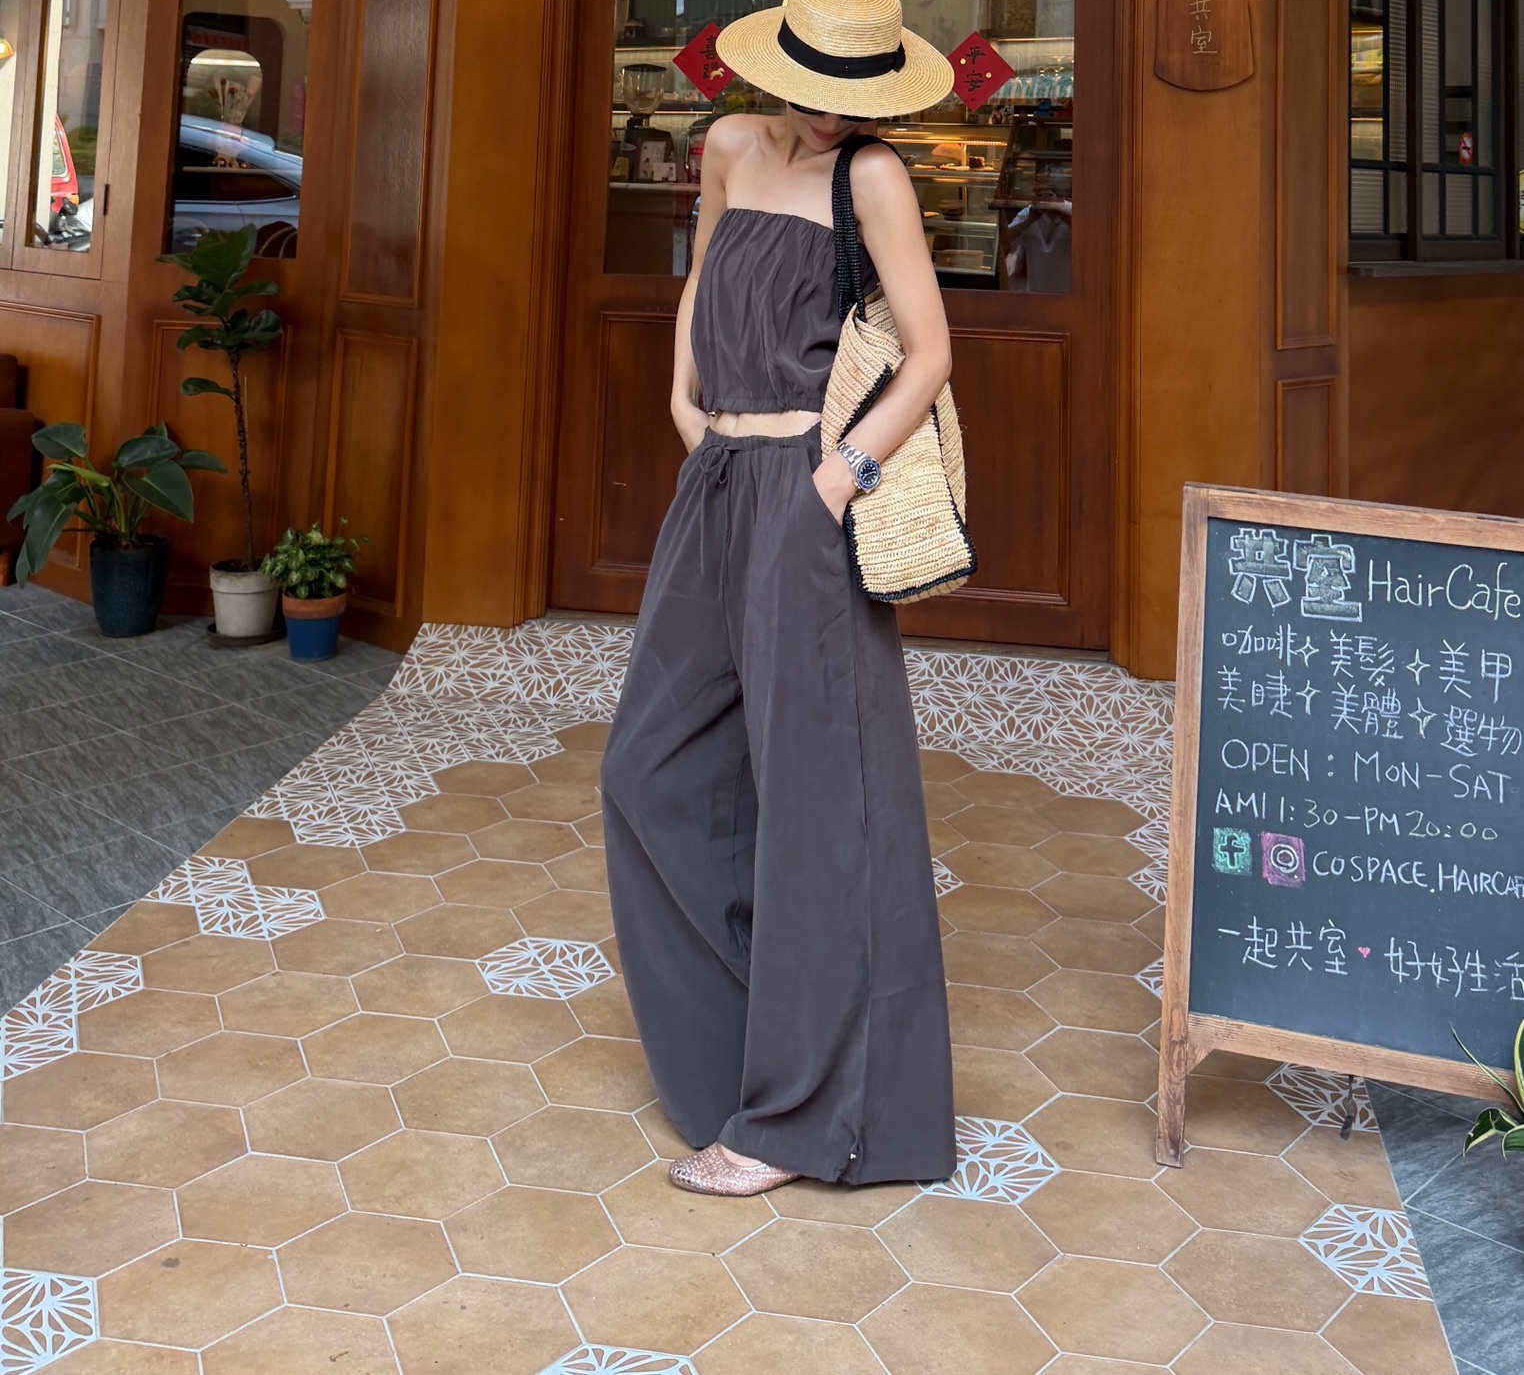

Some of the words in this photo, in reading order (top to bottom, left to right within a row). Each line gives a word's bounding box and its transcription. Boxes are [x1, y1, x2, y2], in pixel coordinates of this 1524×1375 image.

[964, 46, 986, 92] 平安
[1229, 528, 1363, 622] 共室
[1439, 639, 1512, 704] 美甲
[1221, 739, 1310, 782] OPEN
[1312, 850, 1524, 900] COSPACE.HAIRCAF
[1218, 916, 1348, 976] 一起共室
